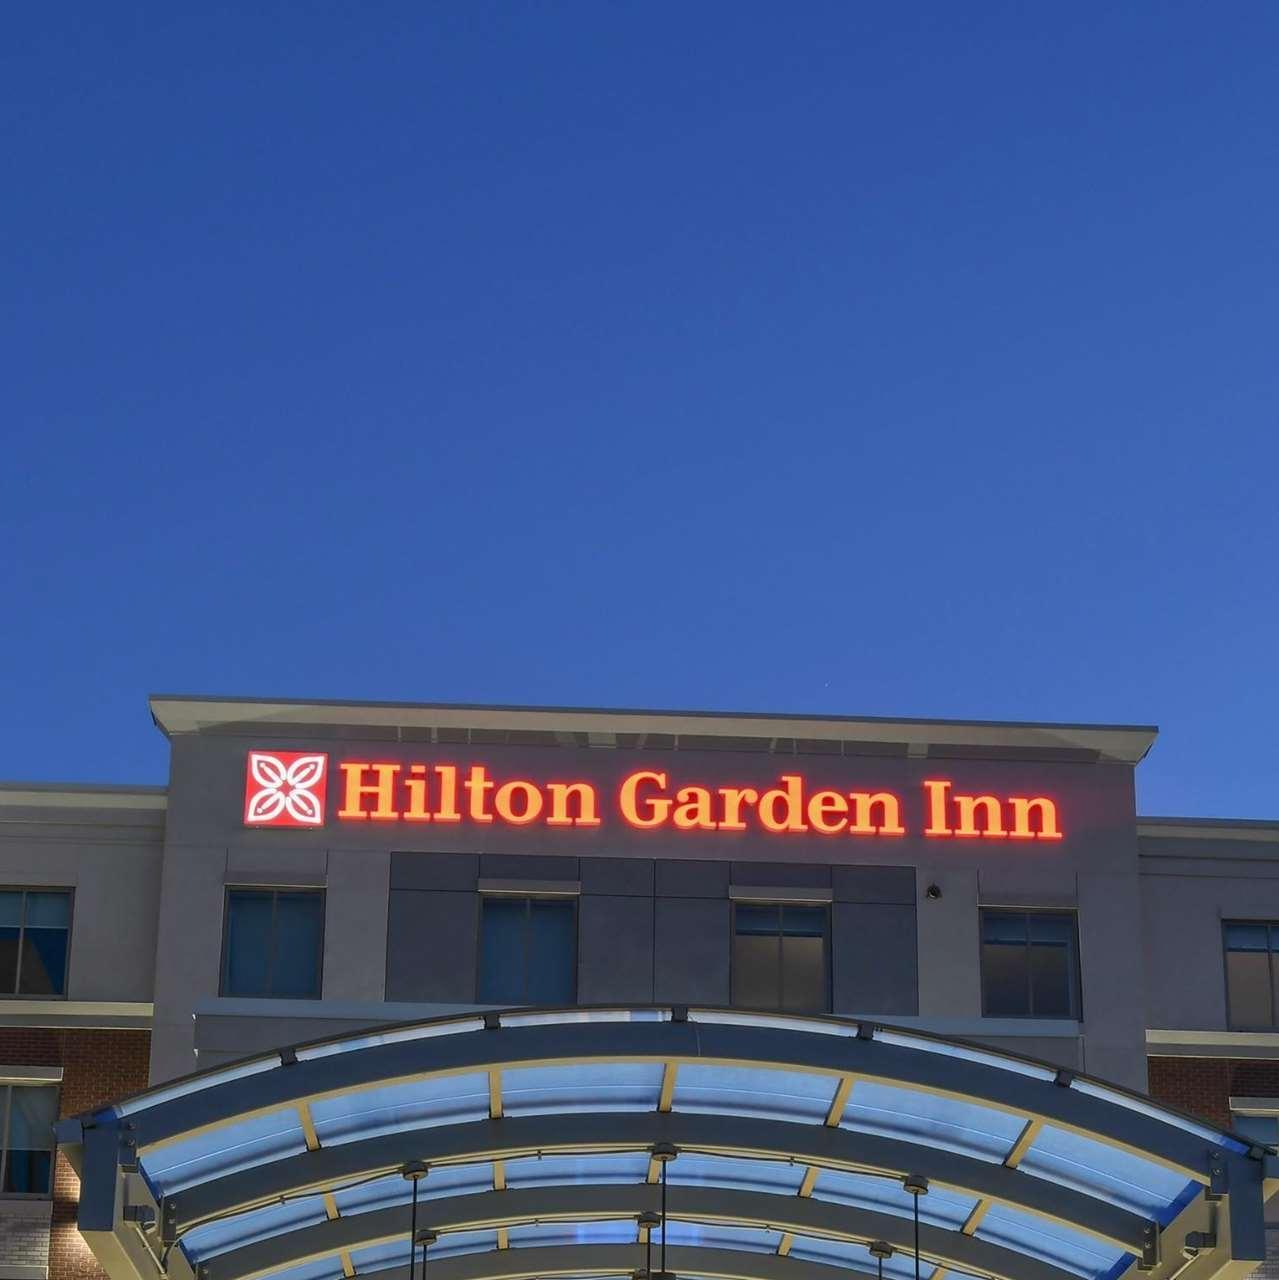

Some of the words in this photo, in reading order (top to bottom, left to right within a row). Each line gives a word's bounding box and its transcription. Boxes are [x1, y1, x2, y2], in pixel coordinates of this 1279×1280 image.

[338, 763, 601, 825] Hilton
[620, 771, 905, 835] Garden
[924, 780, 1062, 839] Inn
